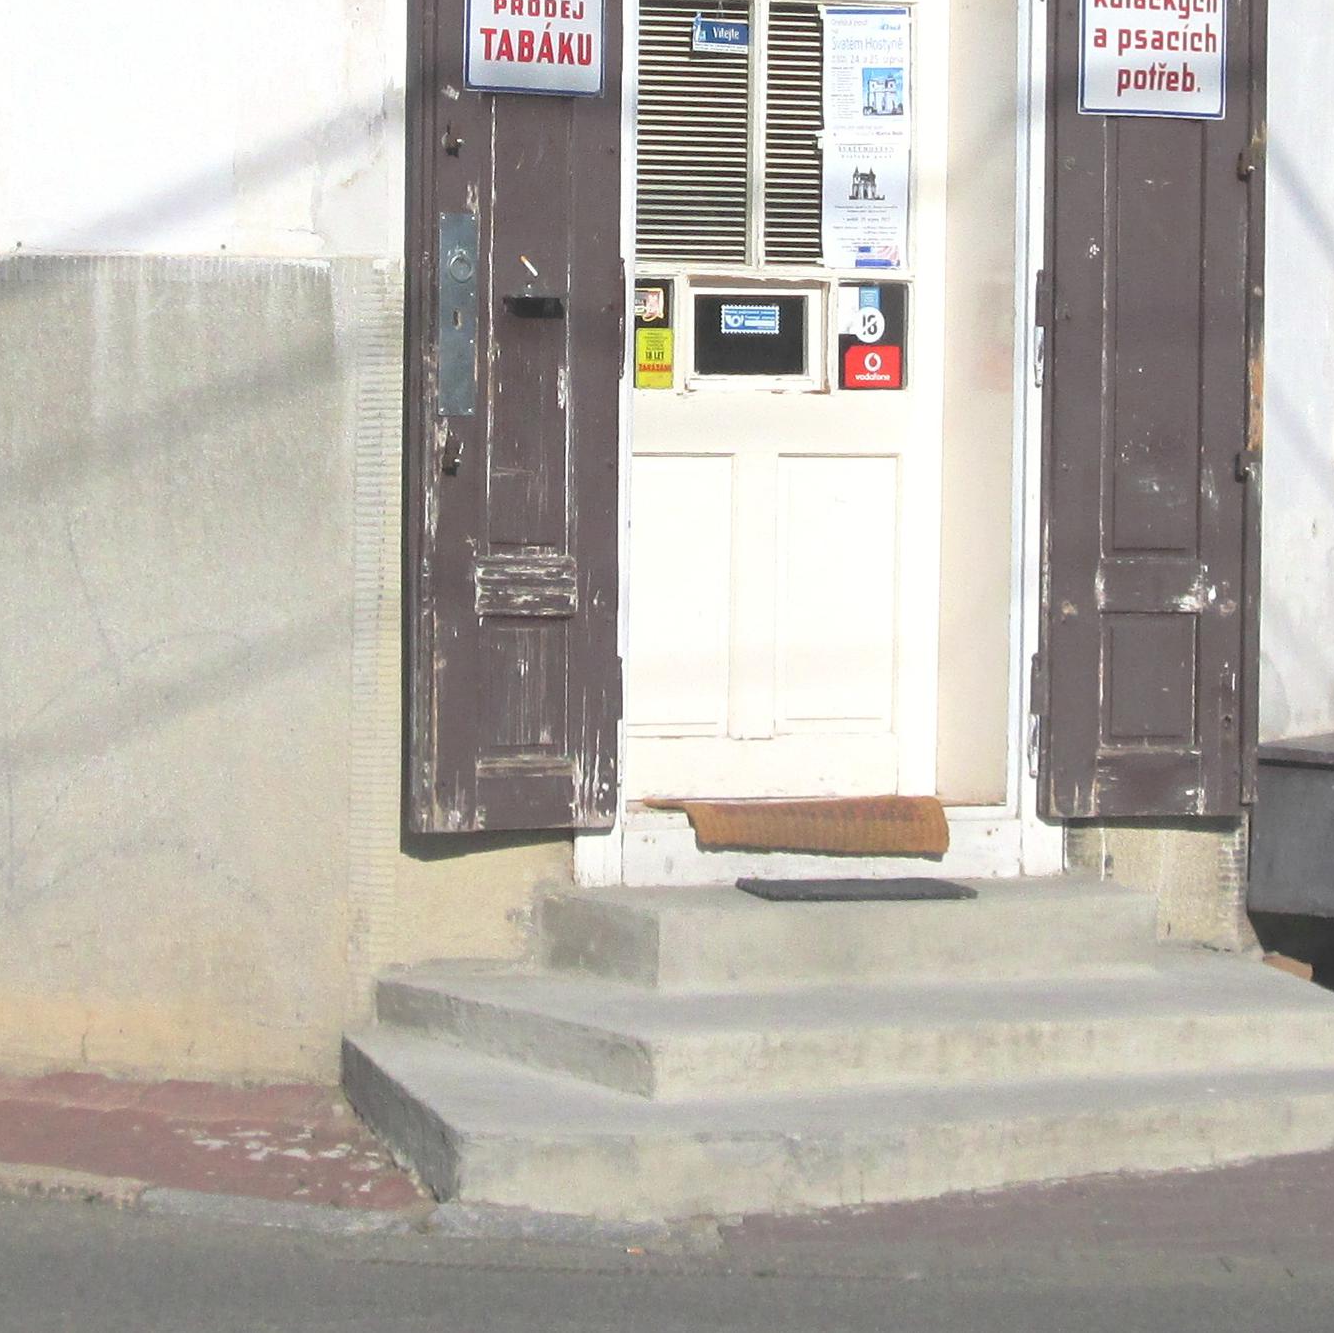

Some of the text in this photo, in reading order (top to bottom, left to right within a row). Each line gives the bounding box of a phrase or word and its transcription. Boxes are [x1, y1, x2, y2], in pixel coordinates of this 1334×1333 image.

[480, 22, 593, 66] TABÁKU
[1094, 23, 1217, 56] a psacích
[1117, 62, 1201, 97] potřeb.
[855, 371, 891, 381] vodafone
